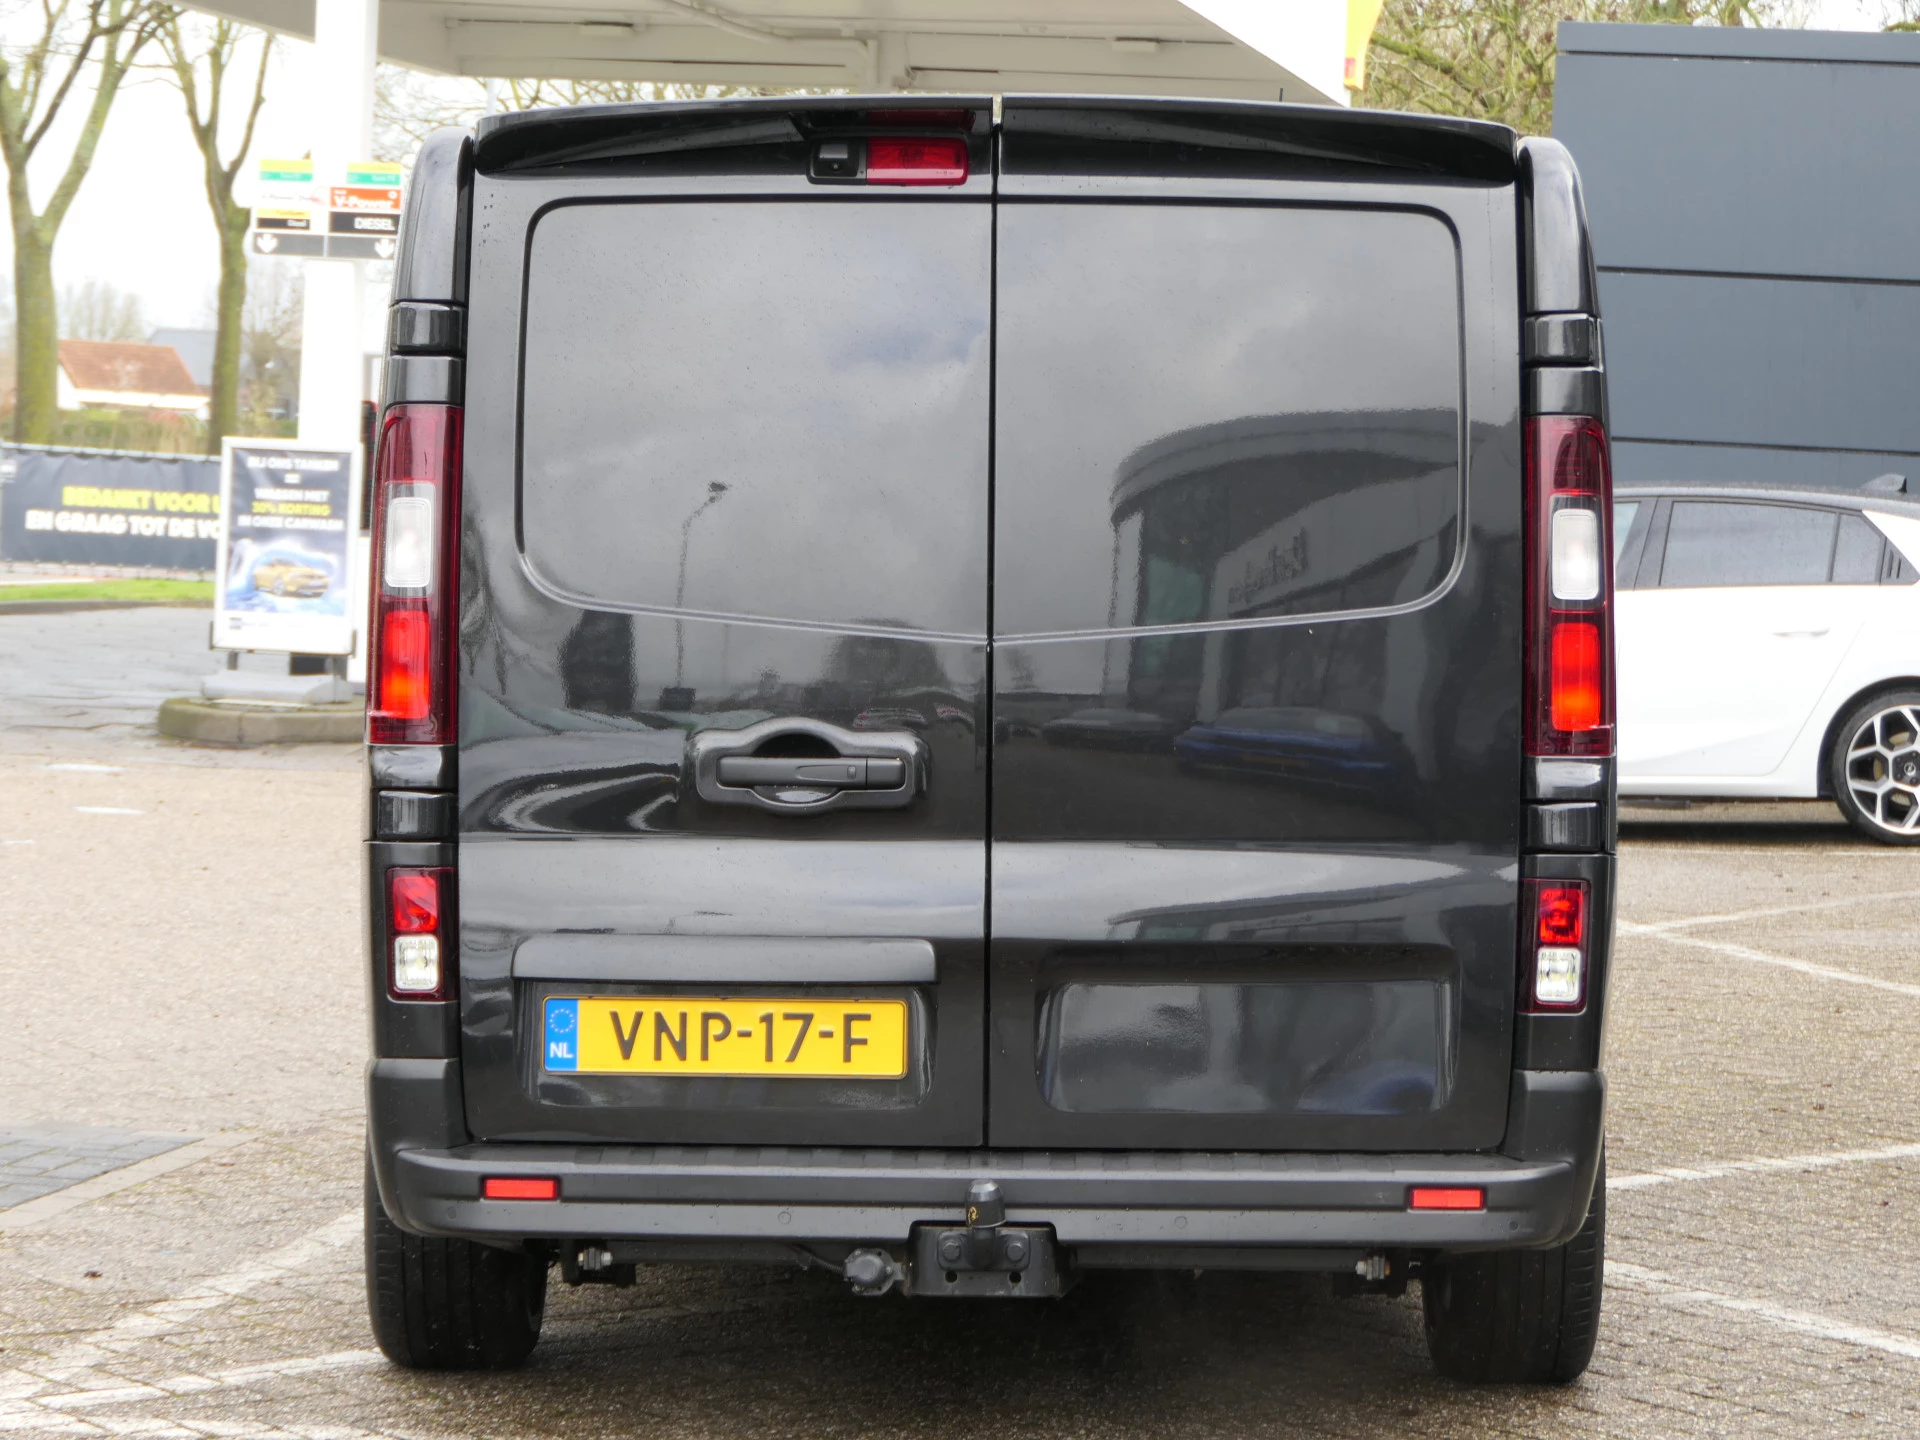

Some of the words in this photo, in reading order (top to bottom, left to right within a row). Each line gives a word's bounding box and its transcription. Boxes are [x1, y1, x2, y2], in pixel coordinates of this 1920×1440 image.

[354, 217, 395, 230] DIESEL
[62, 485, 151, 510] BEDANKT
[153, 491, 209, 514] VOOR
[25, 509, 54, 530] EN
[55, 511, 128, 534] GRAAG
[129, 515, 167, 536] TOT
[167, 517, 196, 538] DE
[549, 1042, 573, 1058] NL
[609, 1010, 872, 1063] VNP-17-F
